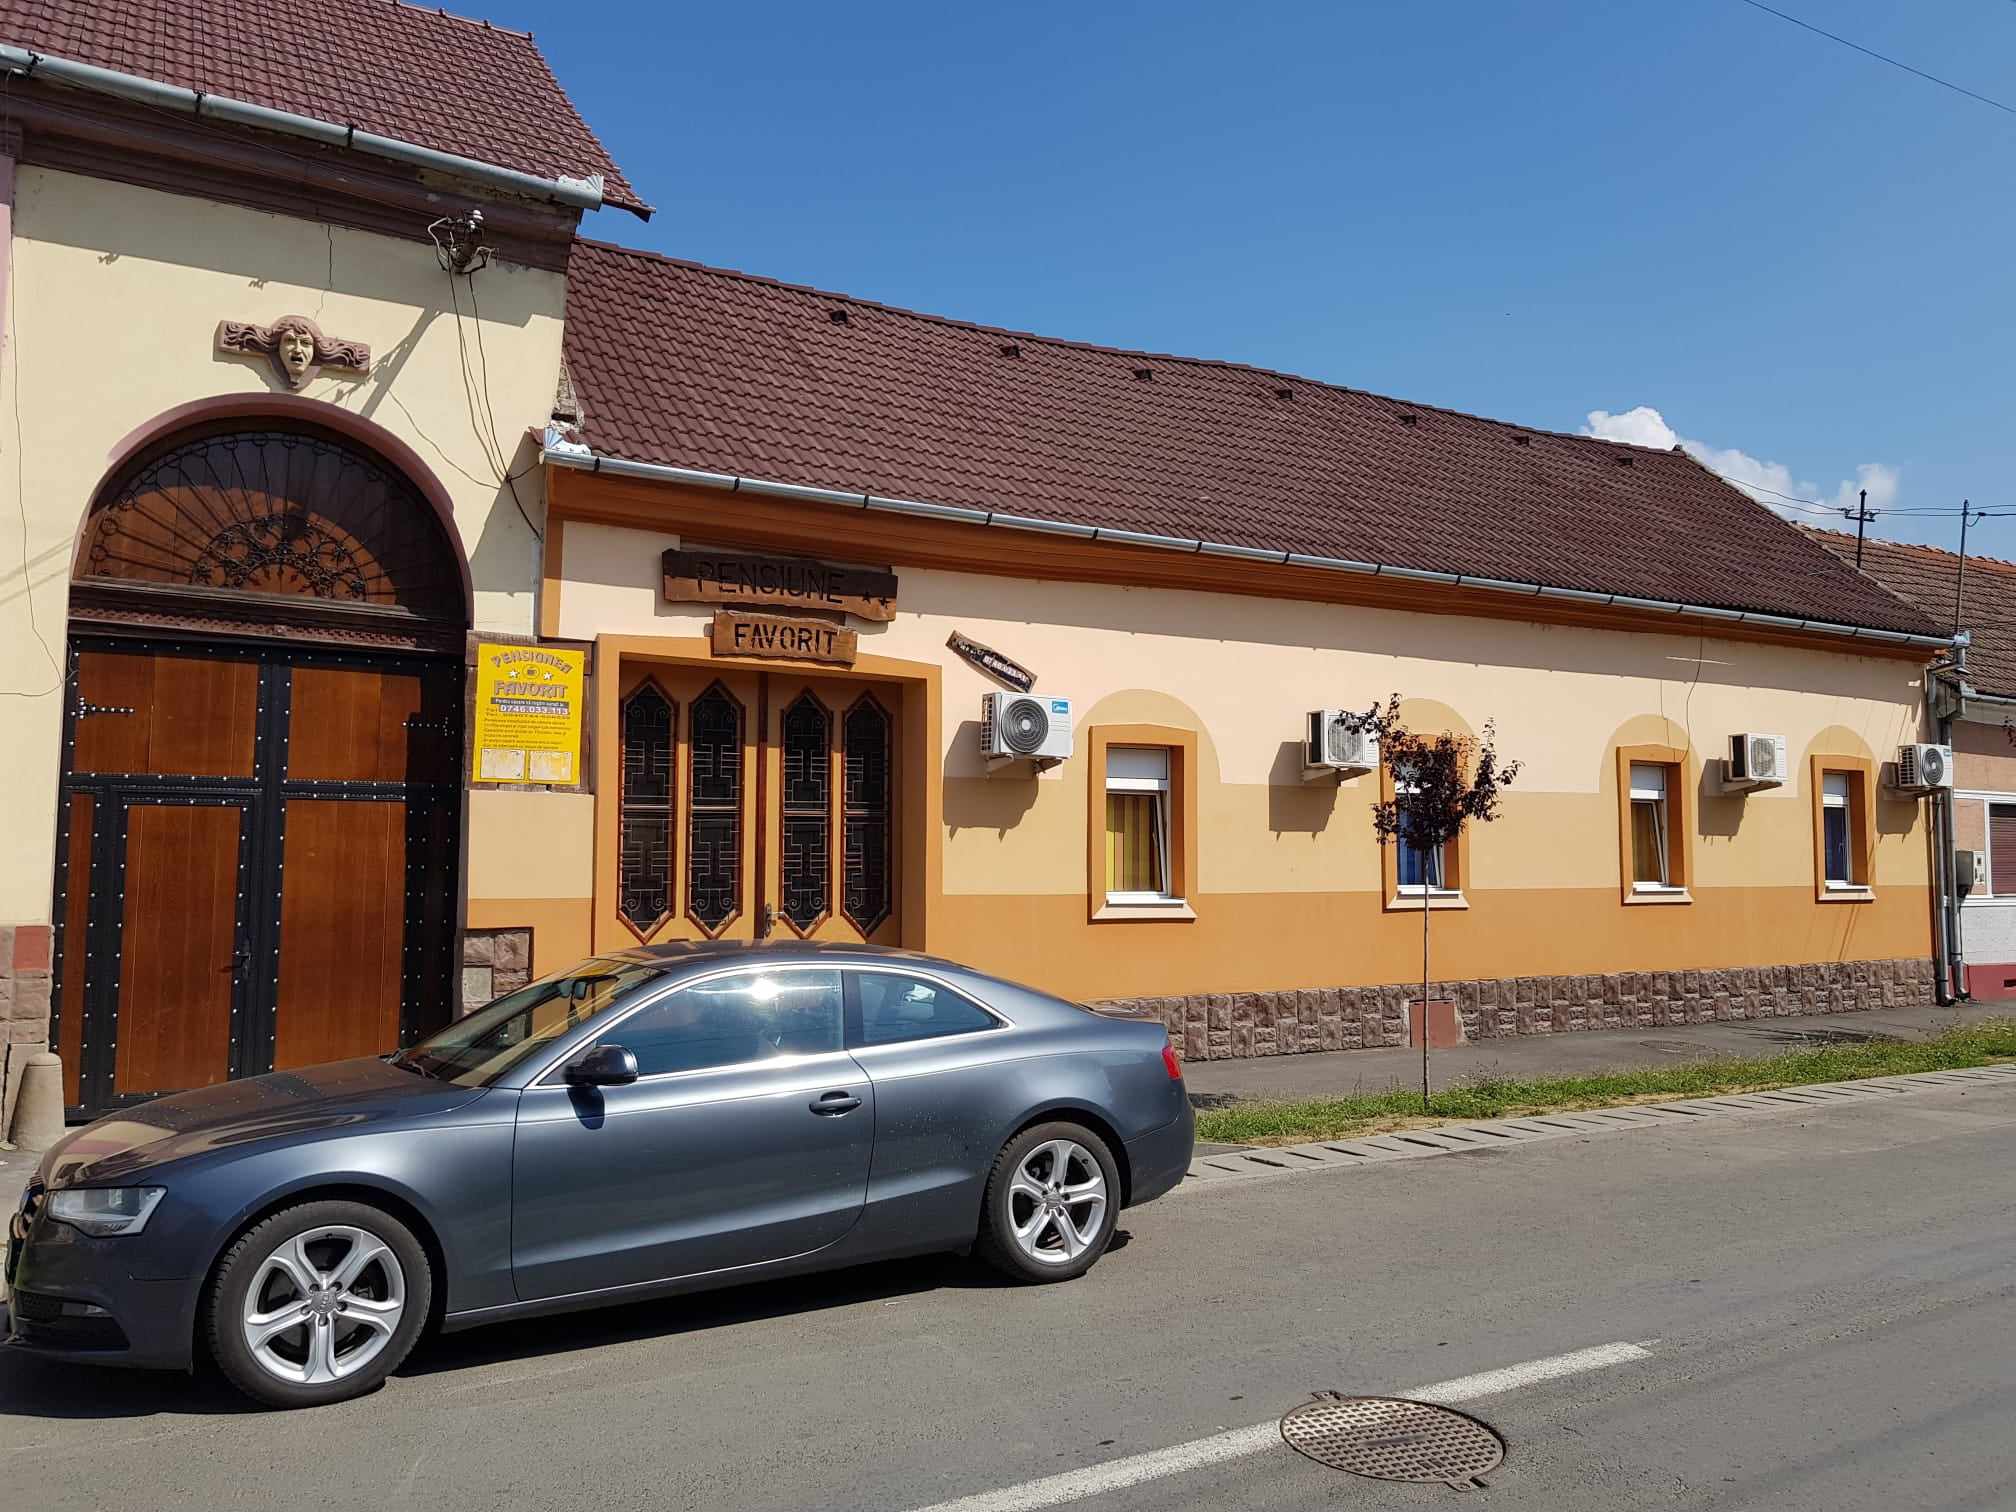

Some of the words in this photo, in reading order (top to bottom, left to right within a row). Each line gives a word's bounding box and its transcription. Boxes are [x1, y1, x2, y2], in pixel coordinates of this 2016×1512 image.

[697, 560, 845, 604] PENSIUNE
[734, 622, 838, 654] FAVORIT
[494, 680, 569, 698] FAVORIT
